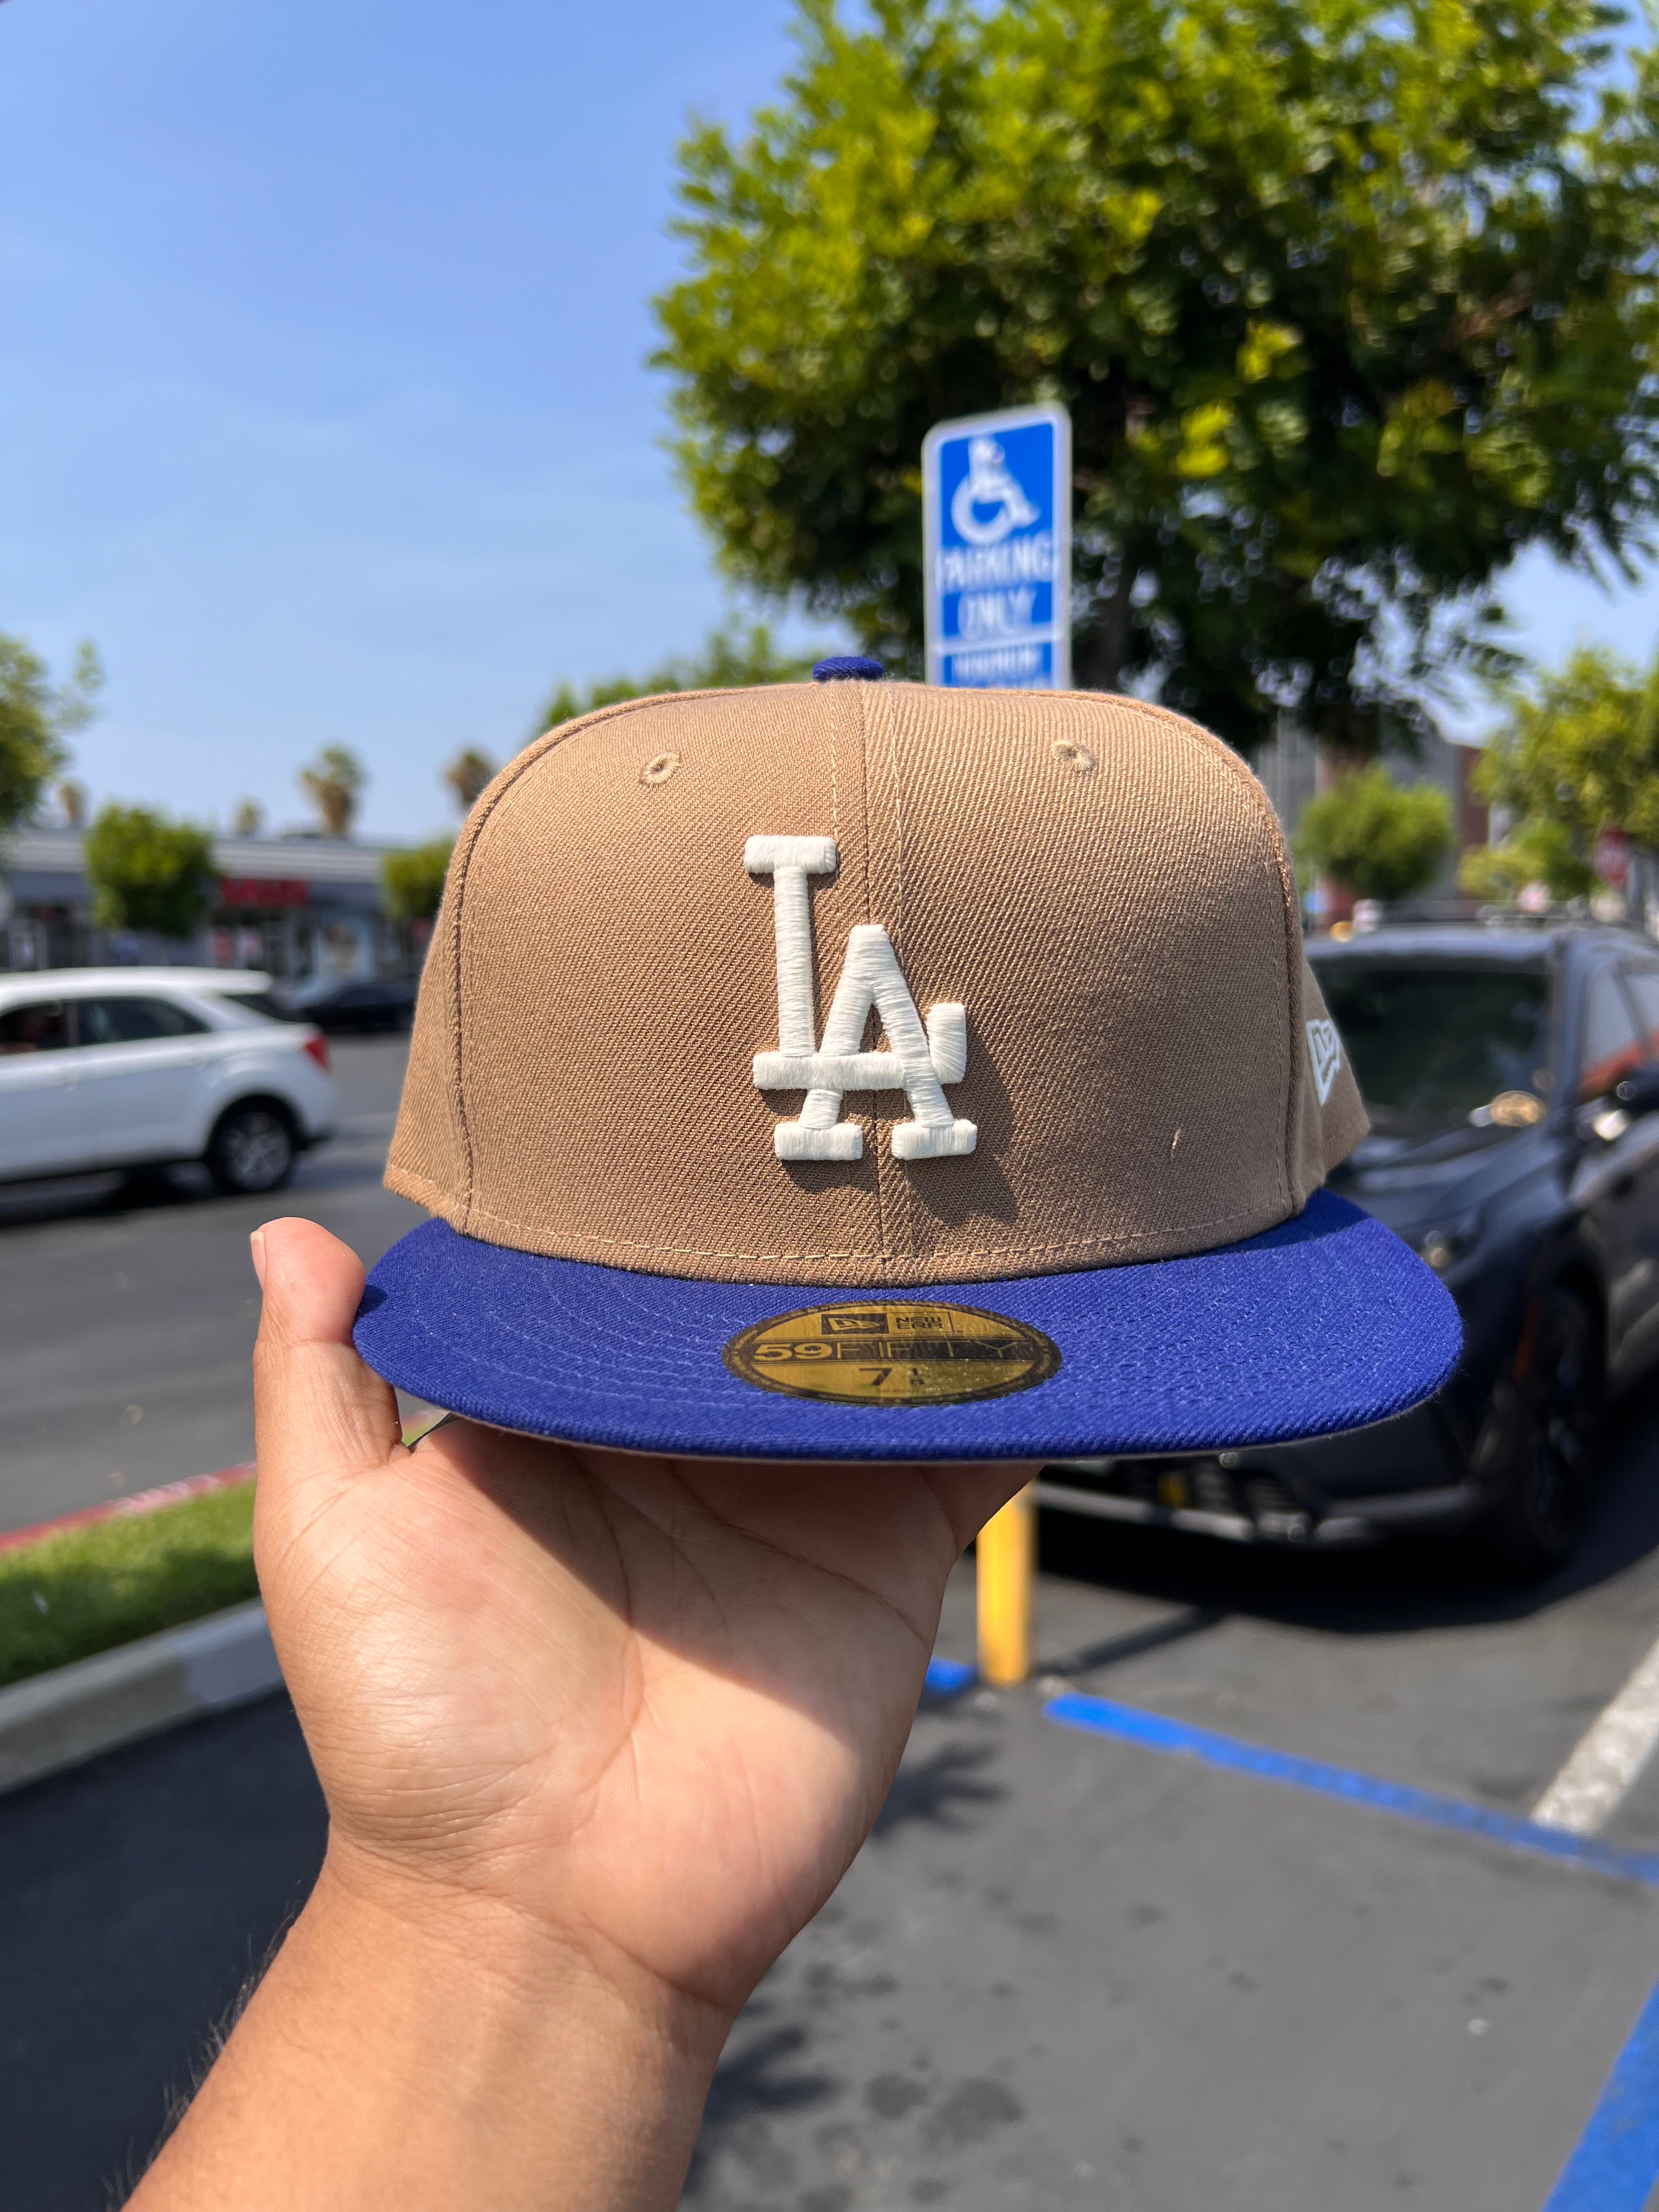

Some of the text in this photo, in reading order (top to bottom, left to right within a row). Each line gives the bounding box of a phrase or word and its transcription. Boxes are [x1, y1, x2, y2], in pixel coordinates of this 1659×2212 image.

[935, 530, 1052, 592] PARKING
[958, 588, 1036, 640] ONLY
[744, 834, 978, 1160] LA
[753, 1341, 1018, 1361] 59FIFTY
